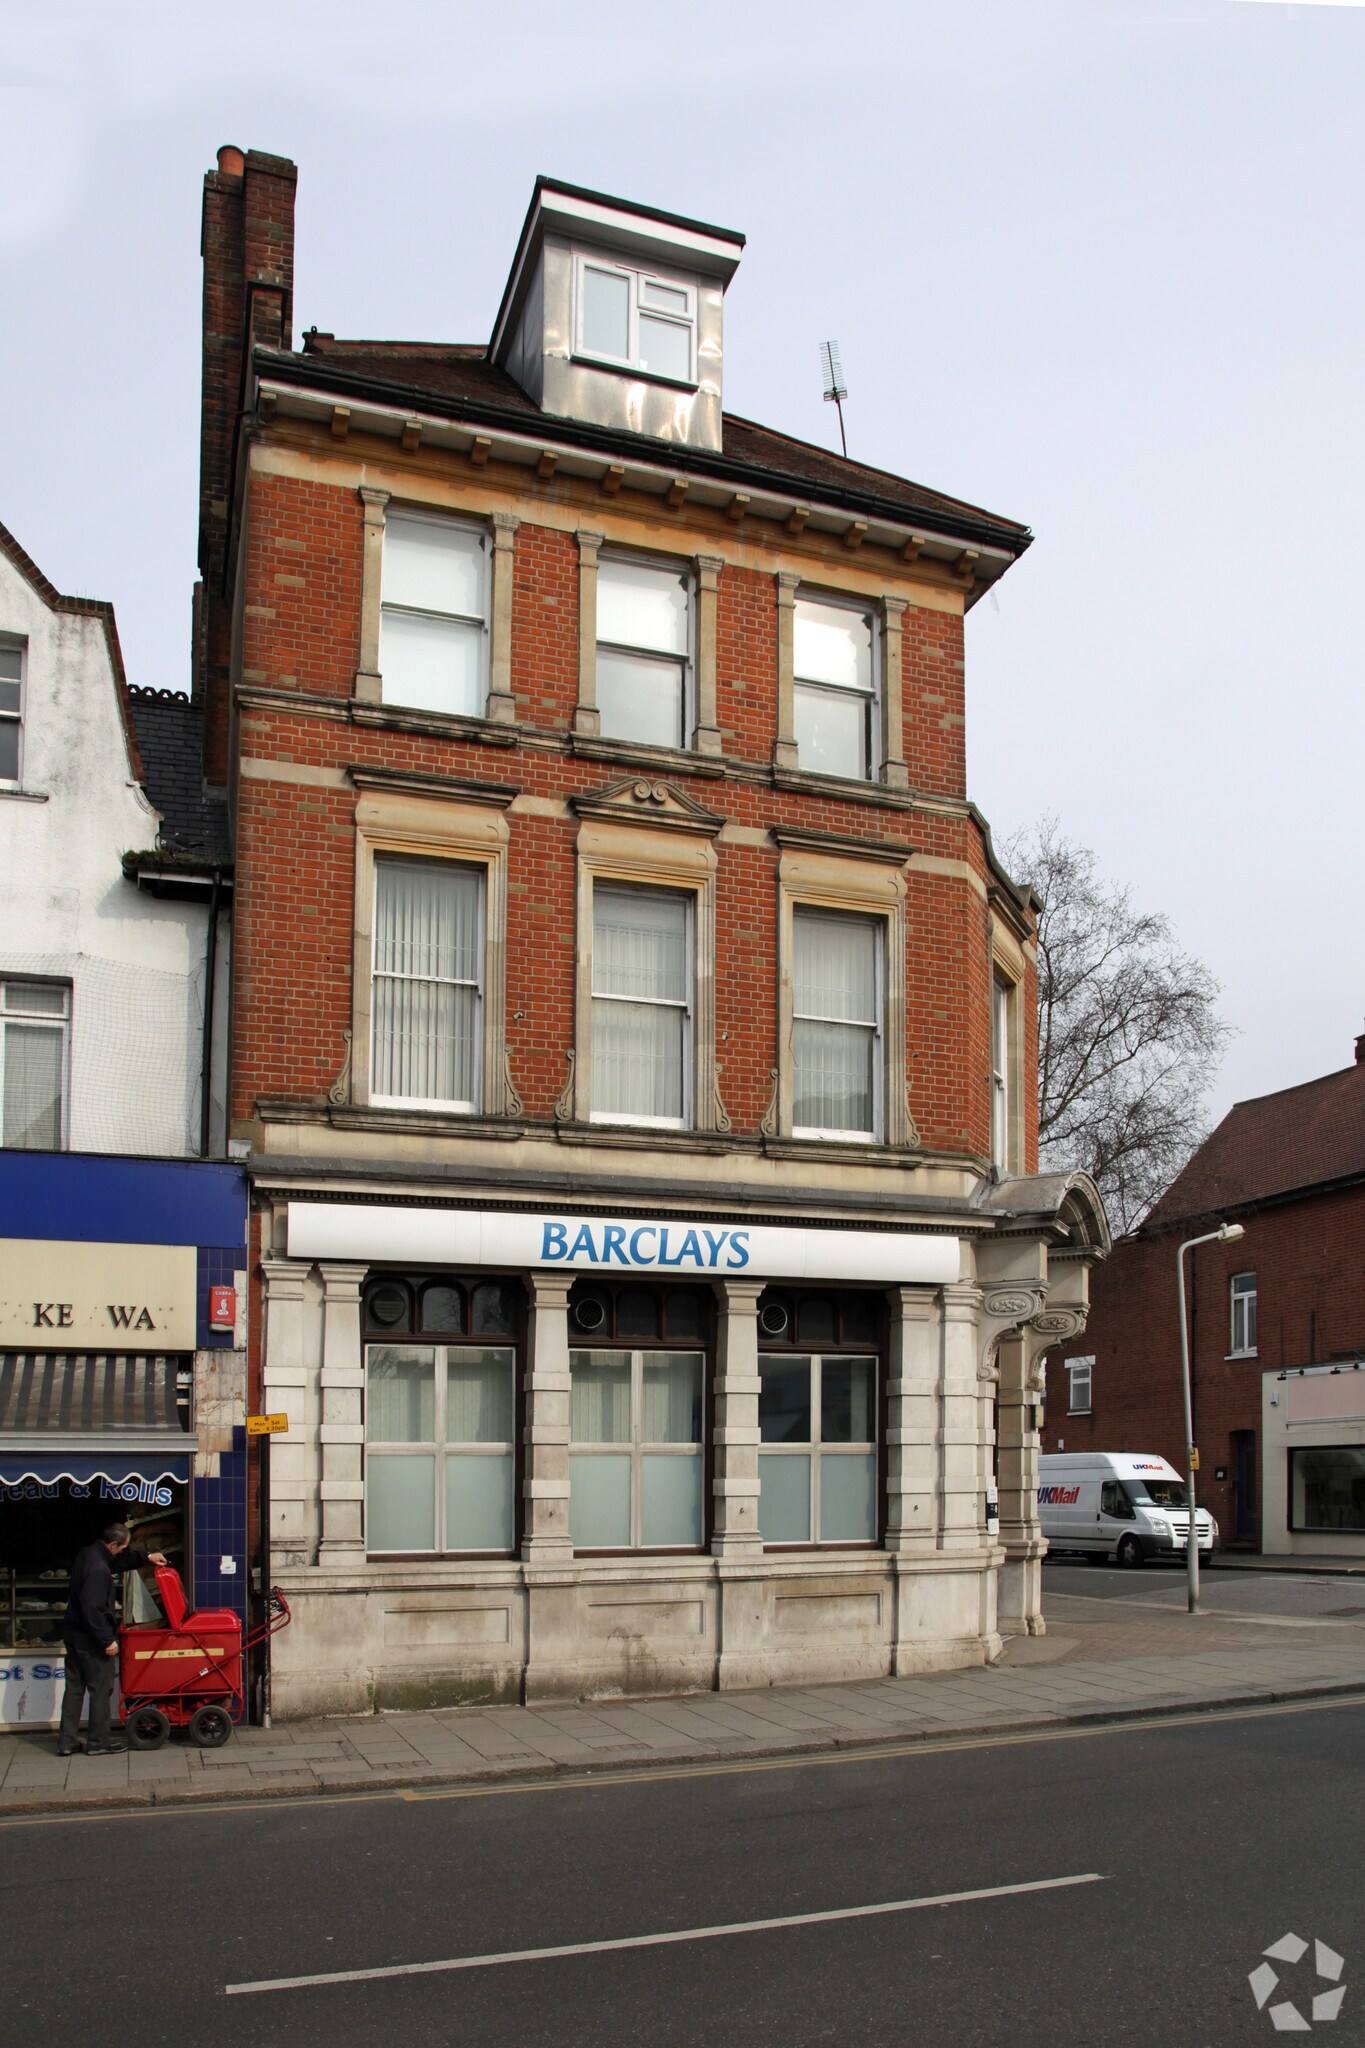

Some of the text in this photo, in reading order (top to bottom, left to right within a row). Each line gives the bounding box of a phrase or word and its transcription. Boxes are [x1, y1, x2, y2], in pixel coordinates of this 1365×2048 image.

[541, 1222, 750, 1269] BARCLAYS
[33, 1303, 156, 1331] KE WA
[100, 1477, 173, 1506] Rolls
[1037, 1486, 1080, 1504] UKMail
